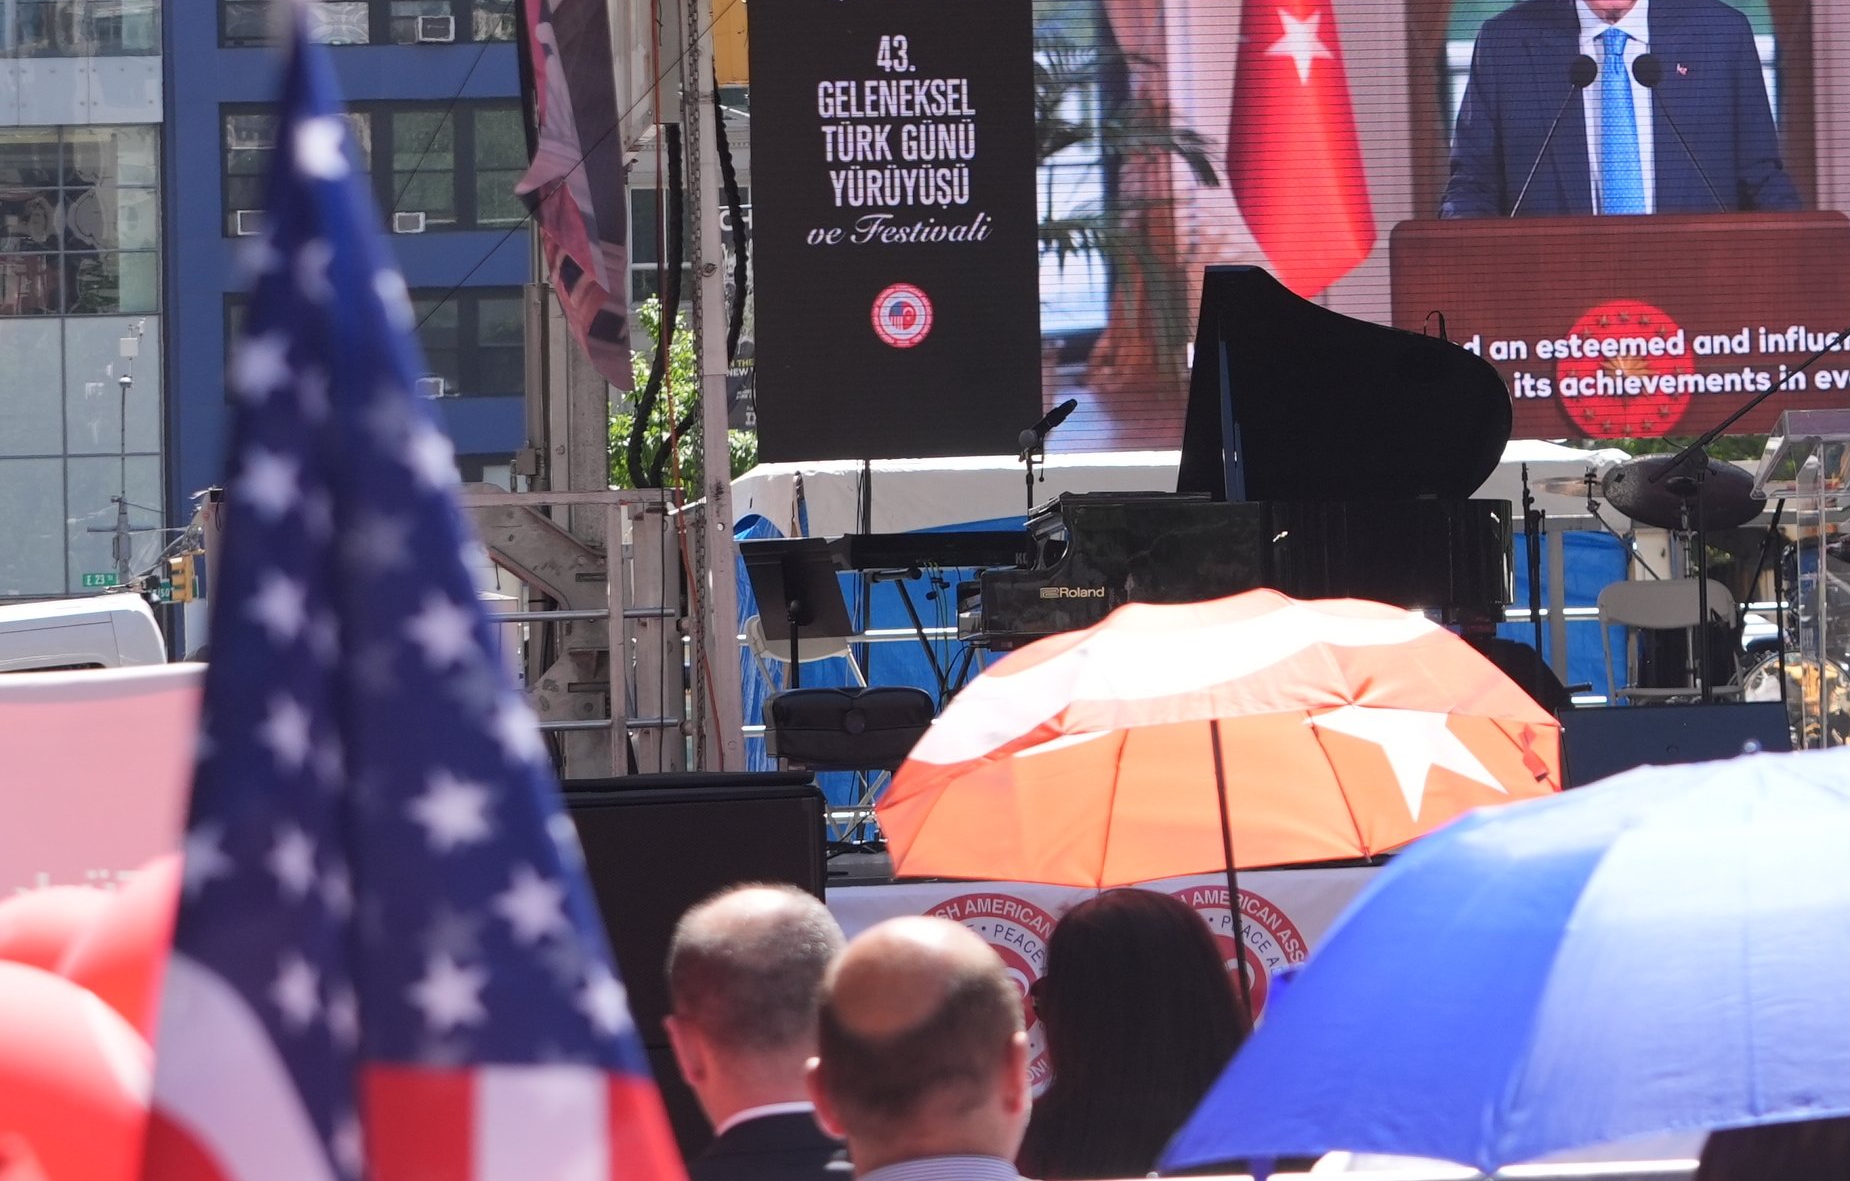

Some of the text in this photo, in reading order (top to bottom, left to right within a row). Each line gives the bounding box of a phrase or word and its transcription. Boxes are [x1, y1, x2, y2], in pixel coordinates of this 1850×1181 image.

[876, 34, 916, 72] 43.
[817, 78, 977, 118] GELENEKSEL
[821, 119, 976, 163] TÜRK GÜNÜ
[829, 163, 970, 210] YÜRÜYÜŞÜ
[806, 212, 993, 246] ve Festivali
[1489, 338, 1528, 360] an
[1535, 329, 1685, 359] esteemed
[1692, 327, 1750, 355] and
[1513, 371, 1552, 398] its
[1559, 366, 1772, 398] achievements
[1779, 364, 1807, 391] in
[95, 574, 105, 585] 23
[1060, 586, 1105, 598] Roland
[993, 923, 1045, 963] PEACE
[1221, 915, 1273, 954] PACE
